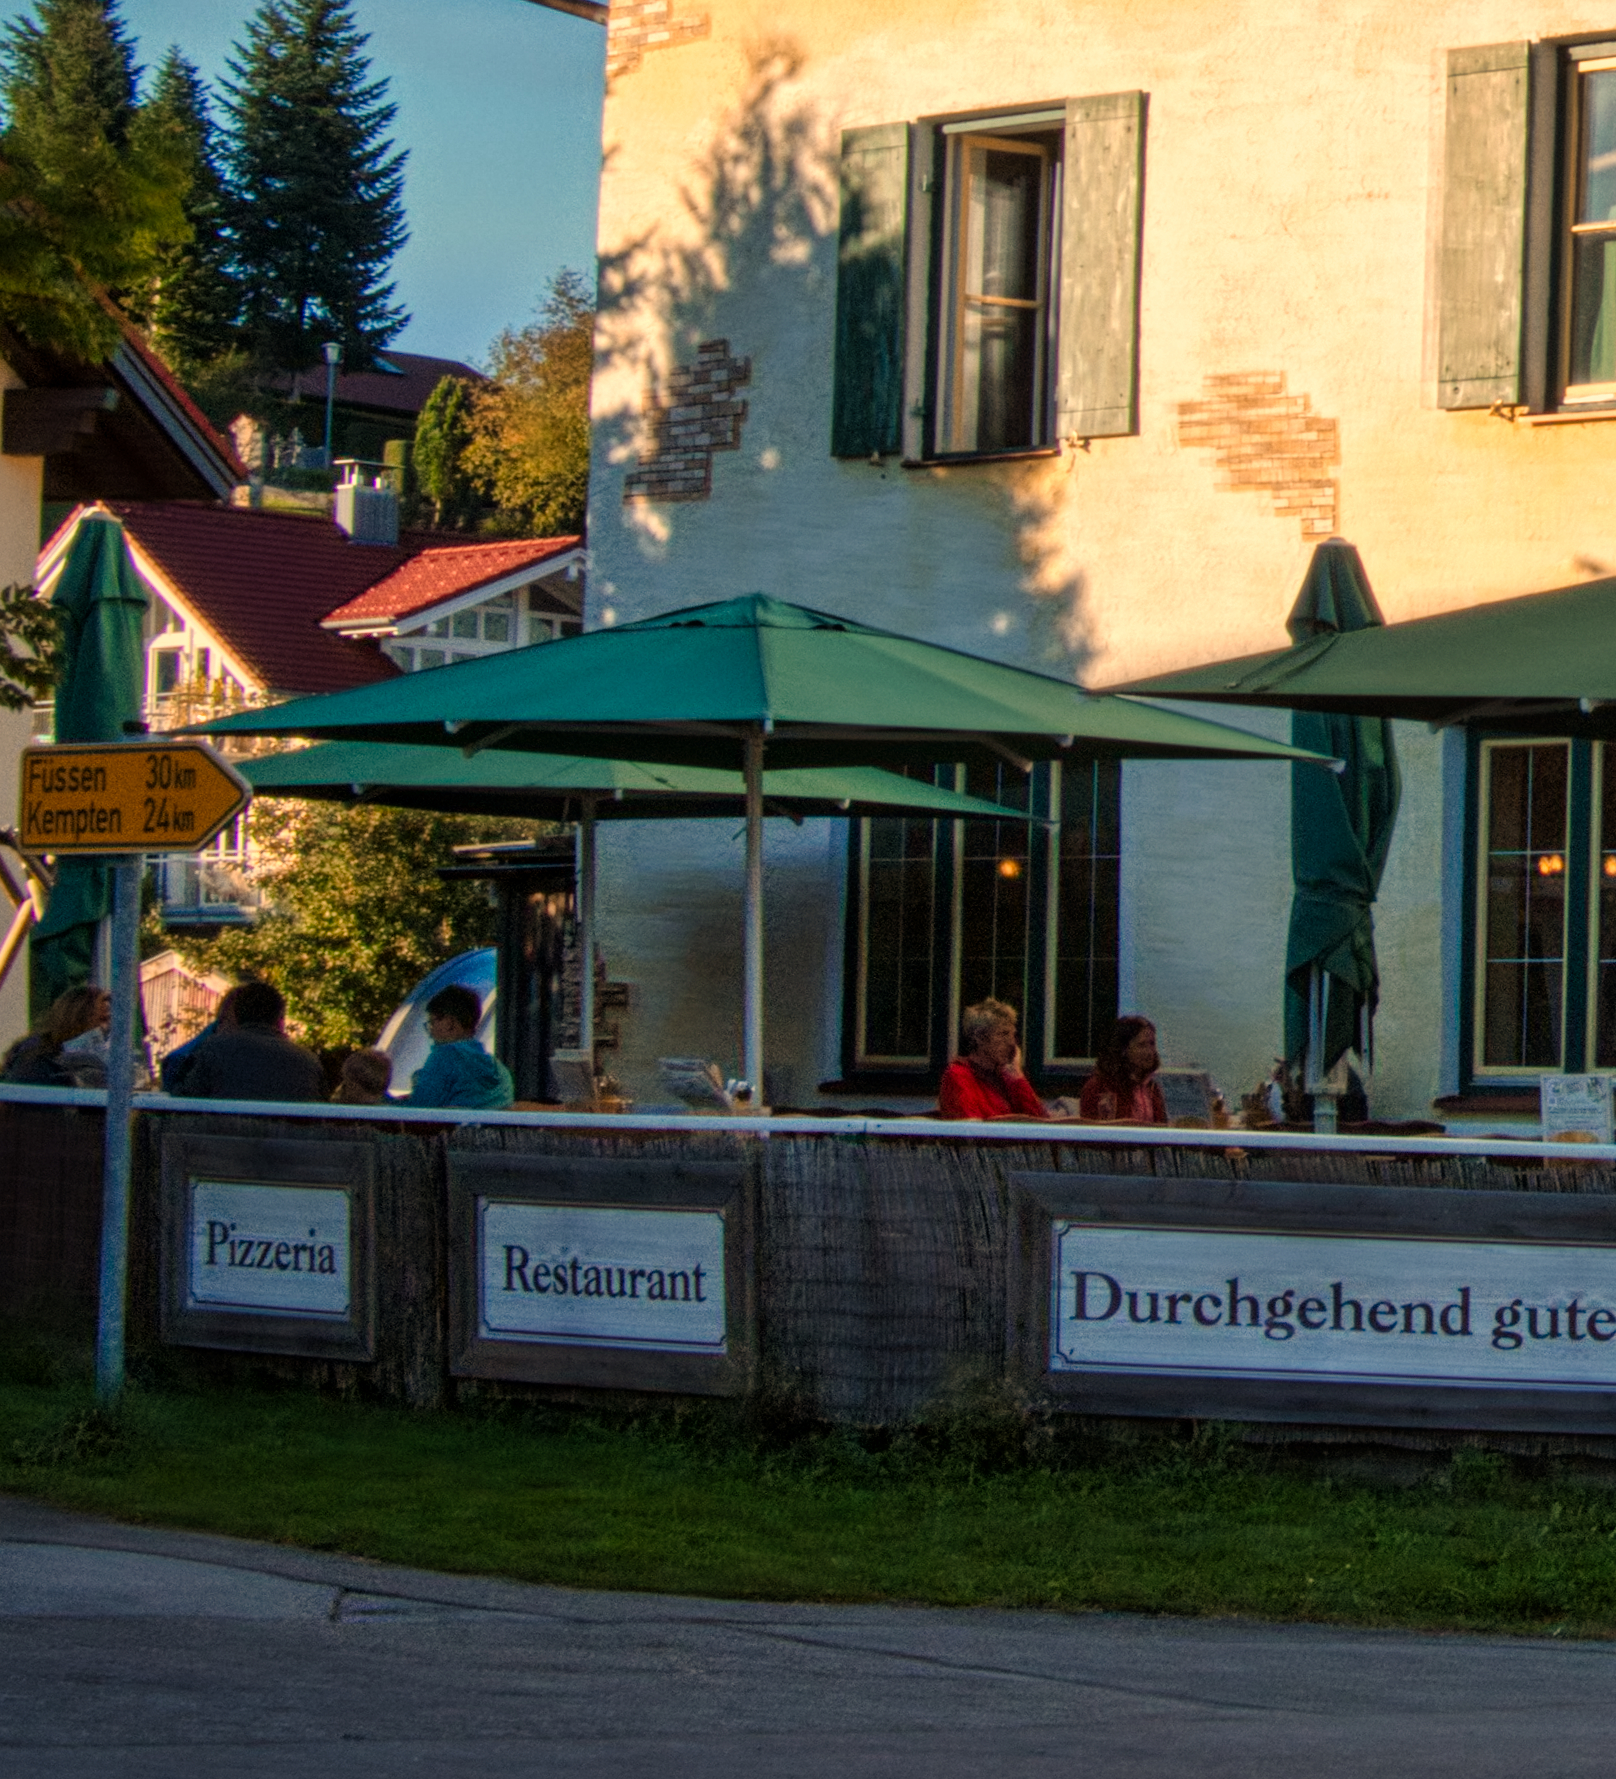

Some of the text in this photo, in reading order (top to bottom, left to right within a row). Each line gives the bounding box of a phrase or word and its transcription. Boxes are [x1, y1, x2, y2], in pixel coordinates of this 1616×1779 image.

[27, 759, 107, 793] Füssen
[27, 800, 122, 842] Kempten
[205, 1220, 337, 1276] Pizzeria
[501, 1244, 707, 1304] Restaurant
[1069, 1268, 1473, 1341] Durchgehend
